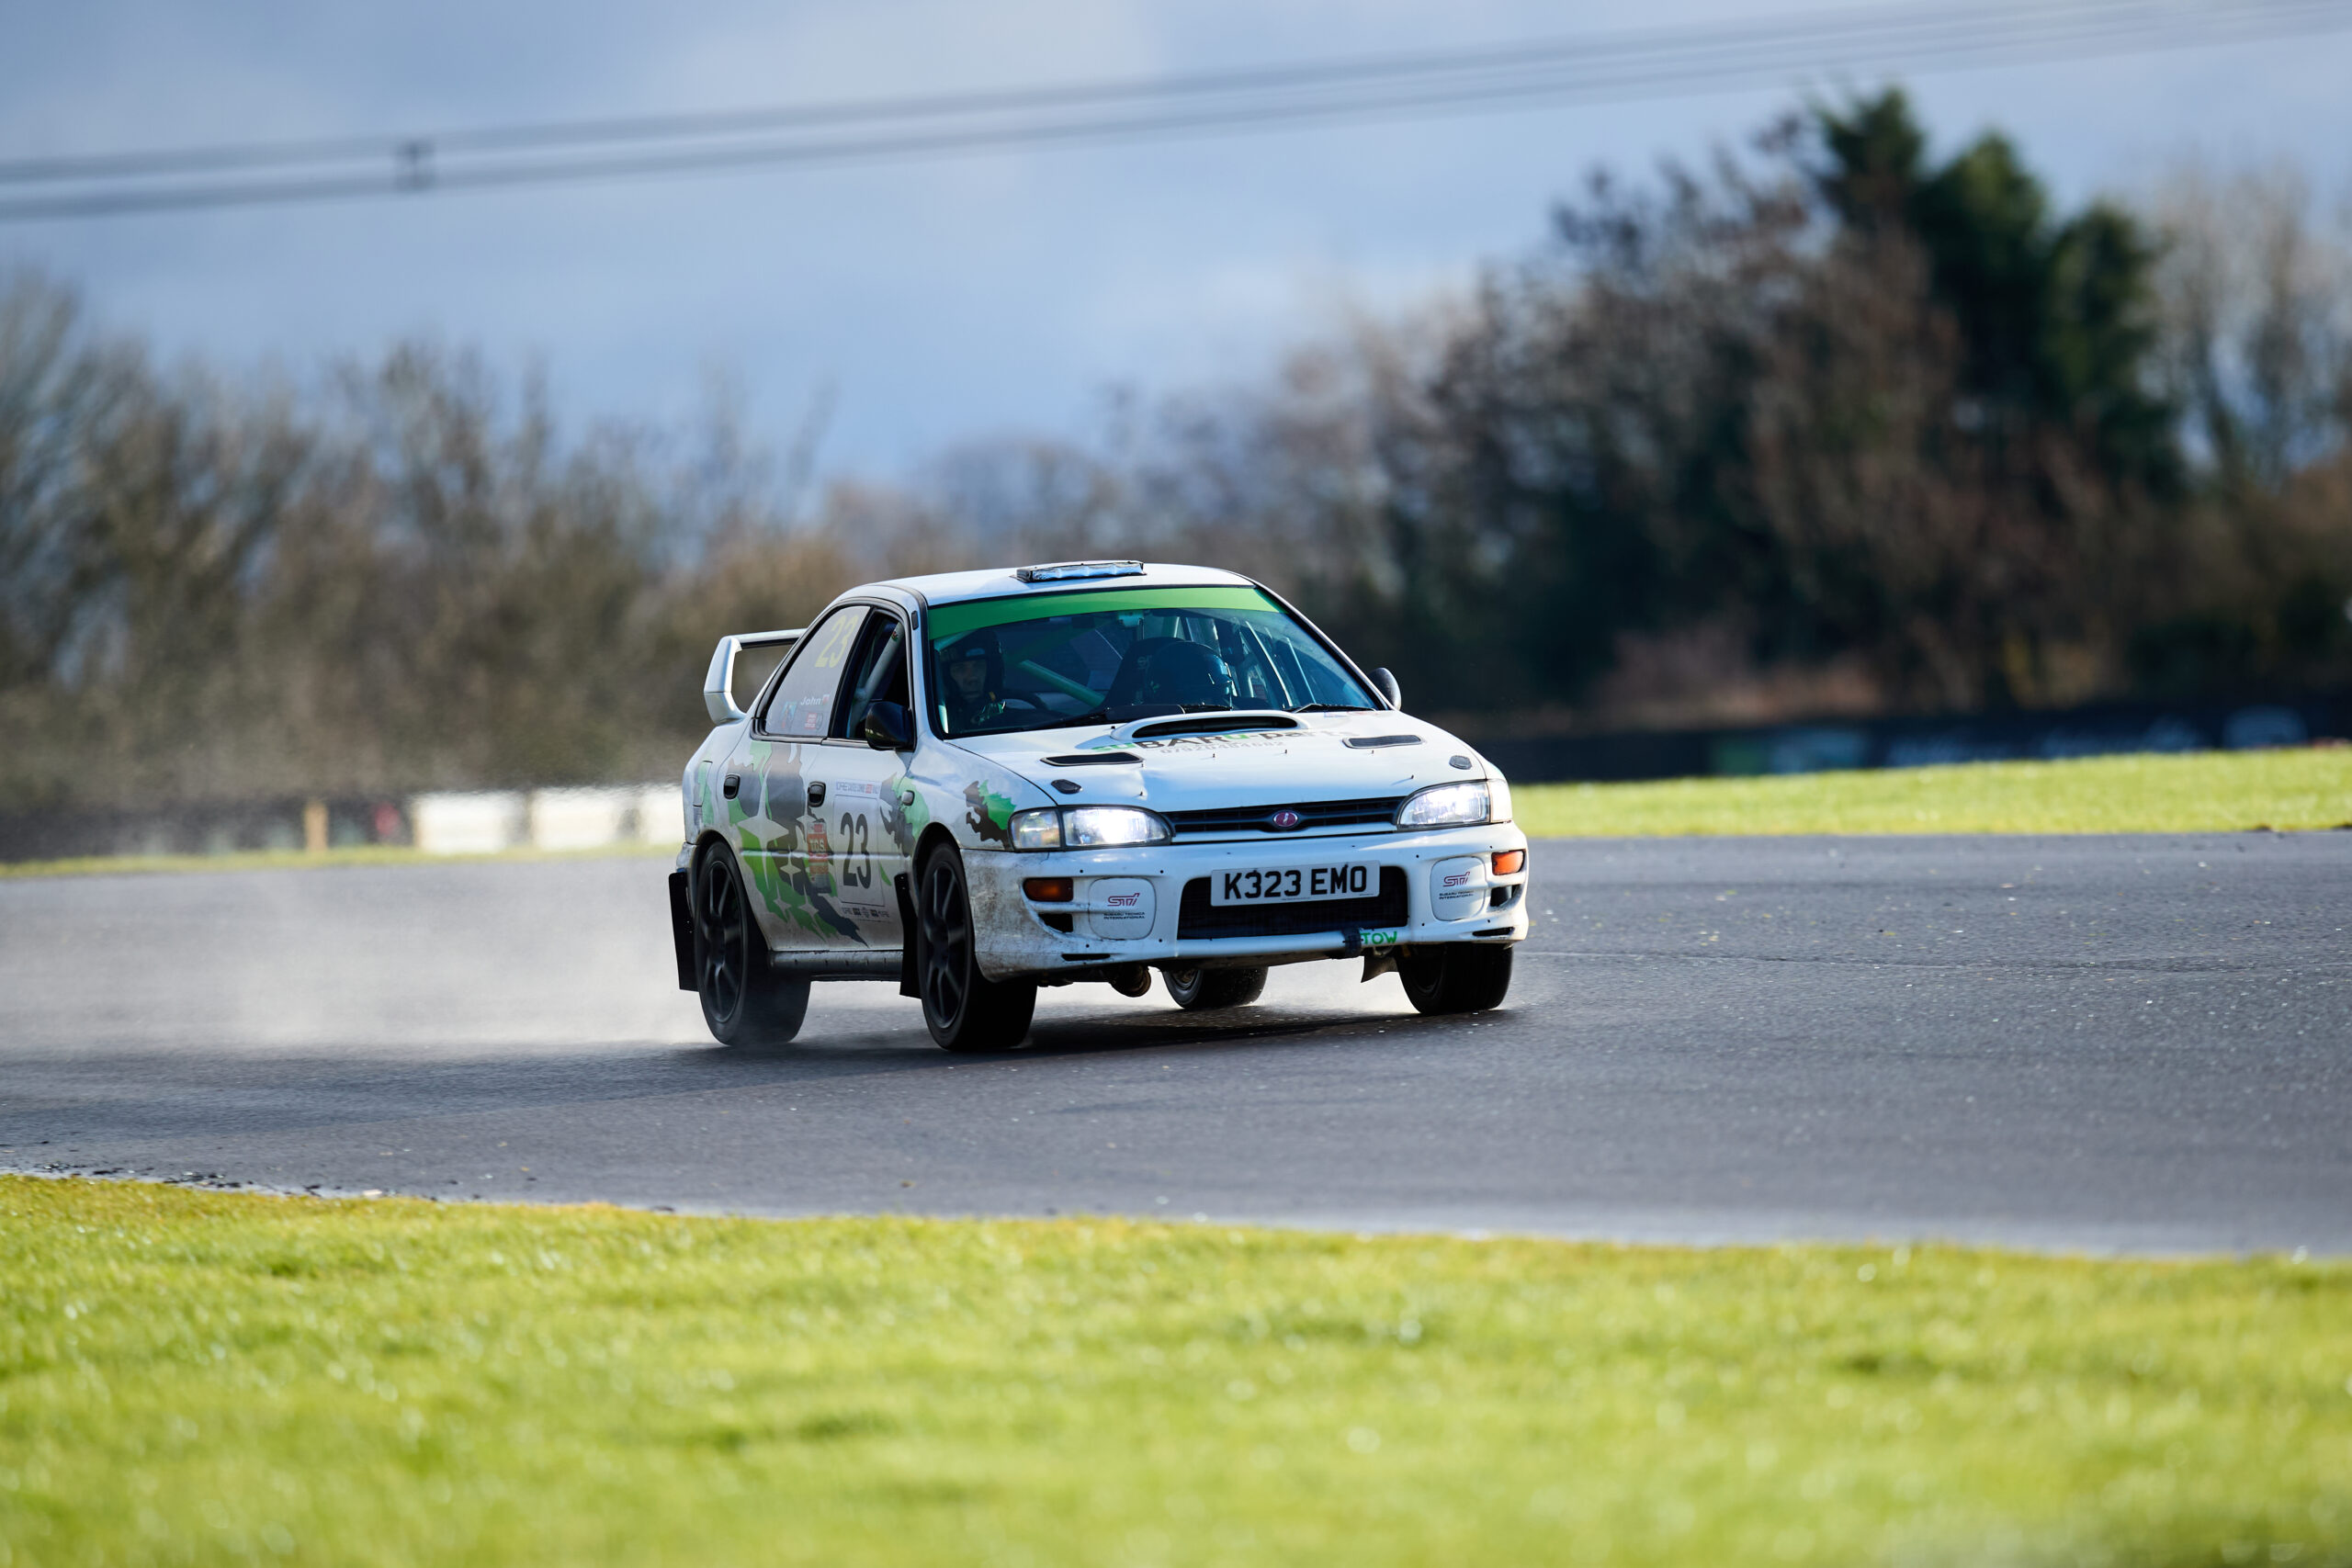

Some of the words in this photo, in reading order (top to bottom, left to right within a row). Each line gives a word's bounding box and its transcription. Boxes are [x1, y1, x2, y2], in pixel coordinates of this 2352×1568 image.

[815, 615, 859, 668] 23
[840, 812, 872, 889] 23
[1224, 870, 1302, 900] K323
[1311, 865, 1368, 896] EMO
[1360, 931, 1397, 945] TOW
